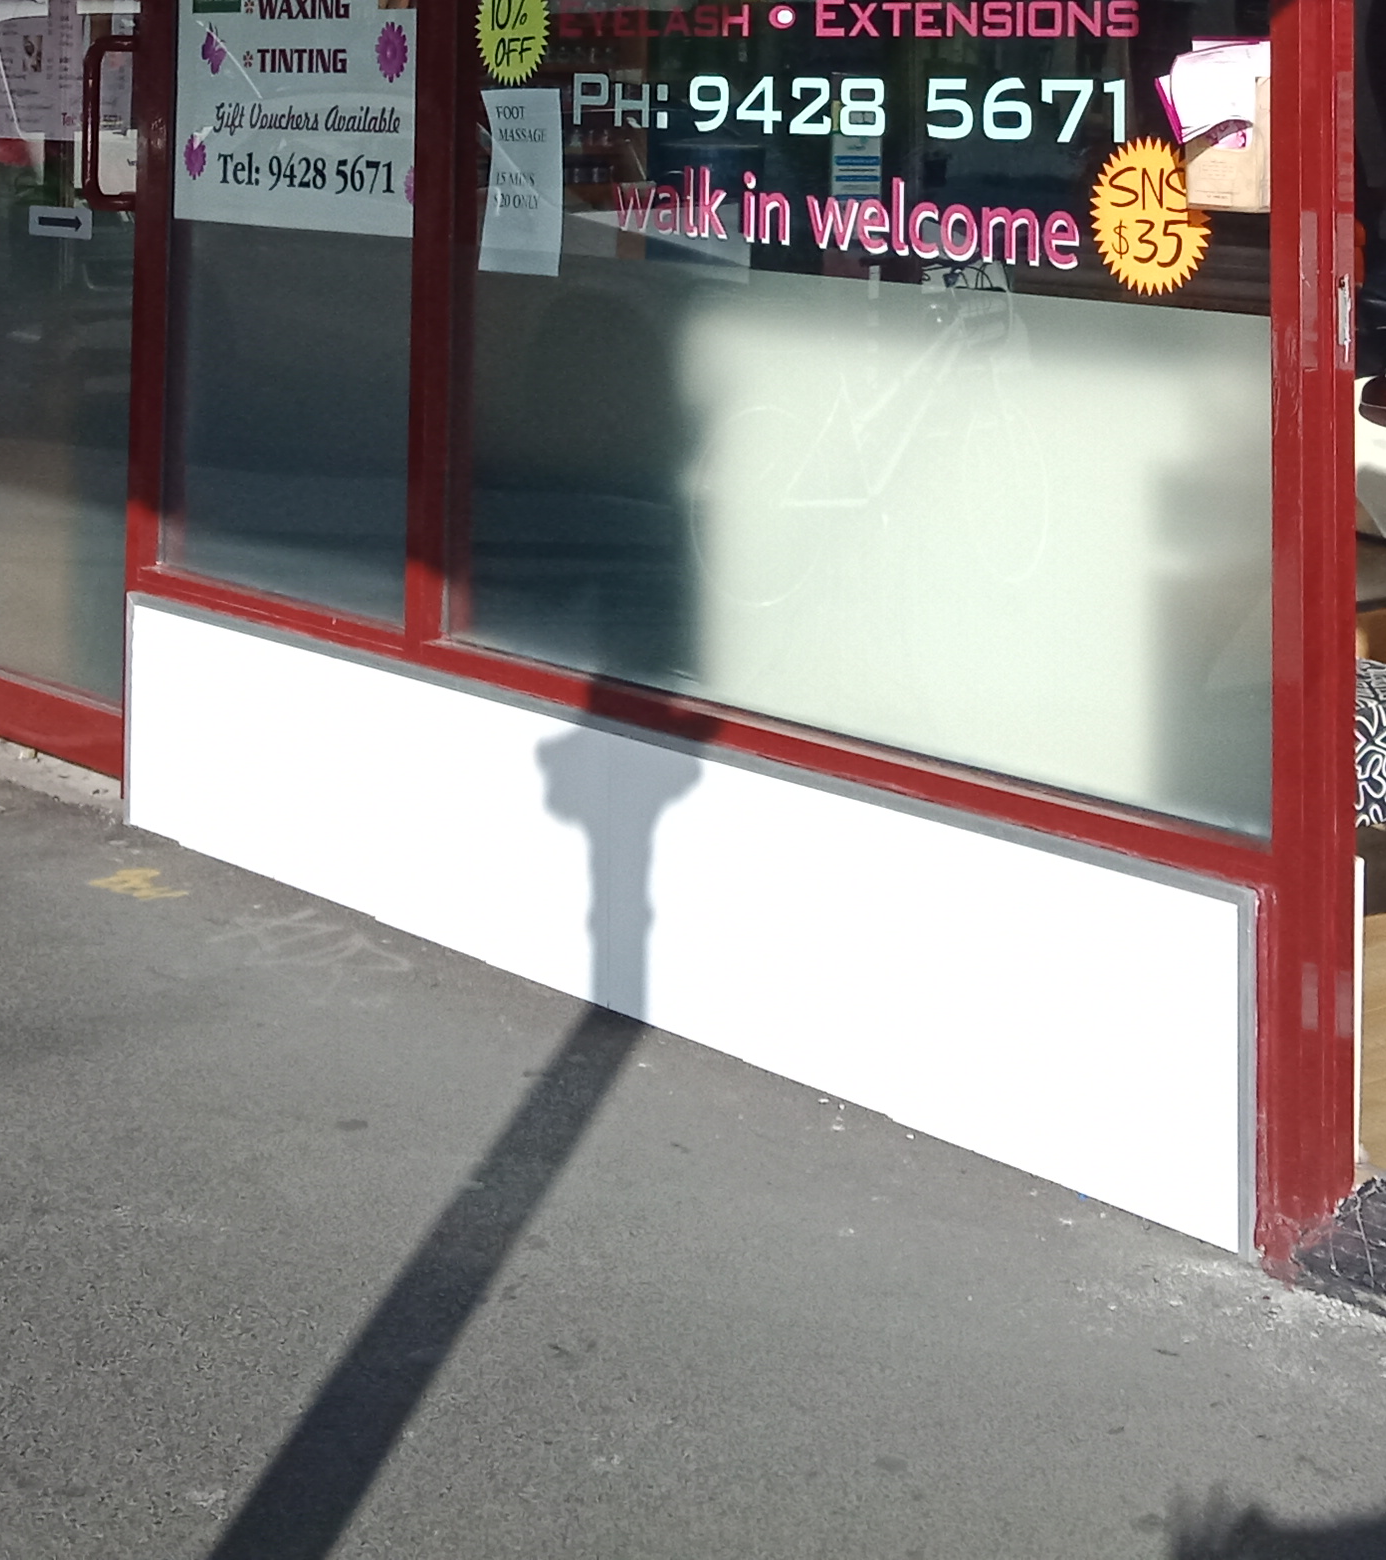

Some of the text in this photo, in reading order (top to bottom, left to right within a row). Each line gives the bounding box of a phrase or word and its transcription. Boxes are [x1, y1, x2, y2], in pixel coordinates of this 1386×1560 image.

[559, 0, 751, 38] EYELASH
[256, 47, 347, 75] TINTING
[493, 37, 535, 68] OFF
[213, 102, 401, 136] Gift Vouchers Available
[496, 106, 526, 120] FOOT
[689, 75, 886, 137] 9428
[925, 78, 1128, 143] 5671
[499, 127, 547, 142] MASSAGE
[217, 152, 395, 194] Tel: 9428 5671
[496, 172, 506, 185] 15
[1109, 165, 1190, 214] SNS
[513, 195, 539, 209] ONLY
[614, 166, 728, 239] walk
[743, 173, 791, 246] in
[810, 176, 1081, 270] welcome
[1111, 218, 1191, 269] $35
